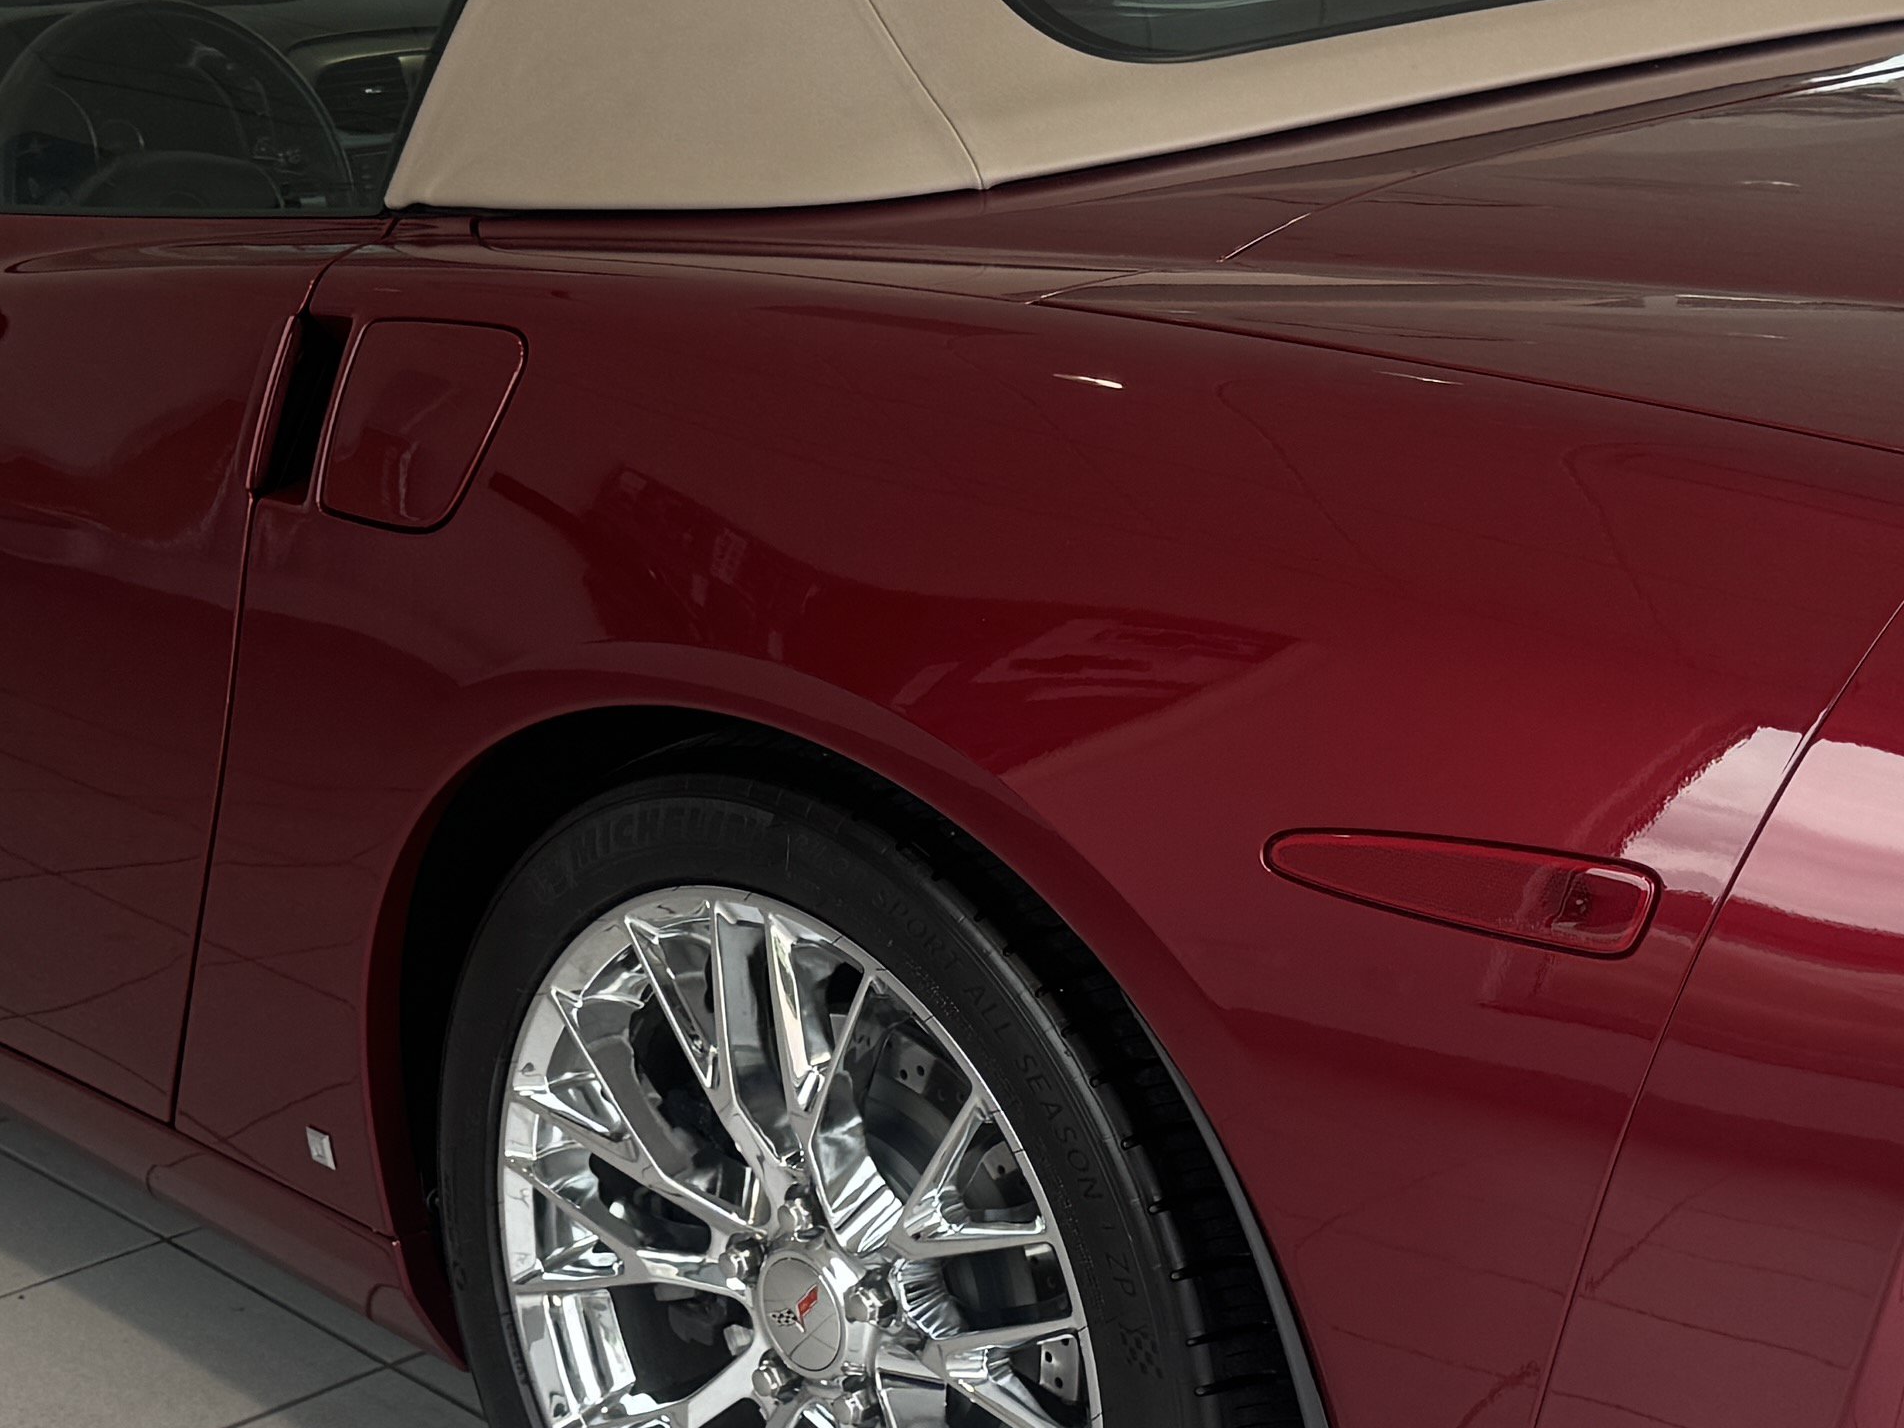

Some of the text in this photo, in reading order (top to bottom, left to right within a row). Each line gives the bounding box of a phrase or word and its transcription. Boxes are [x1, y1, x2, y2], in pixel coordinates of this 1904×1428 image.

[872, 889, 958, 977] SPORT
[963, 982, 1010, 1044] ALL
[1015, 1052, 1104, 1202] SEASON
[1105, 1252, 1136, 1295] ZP
